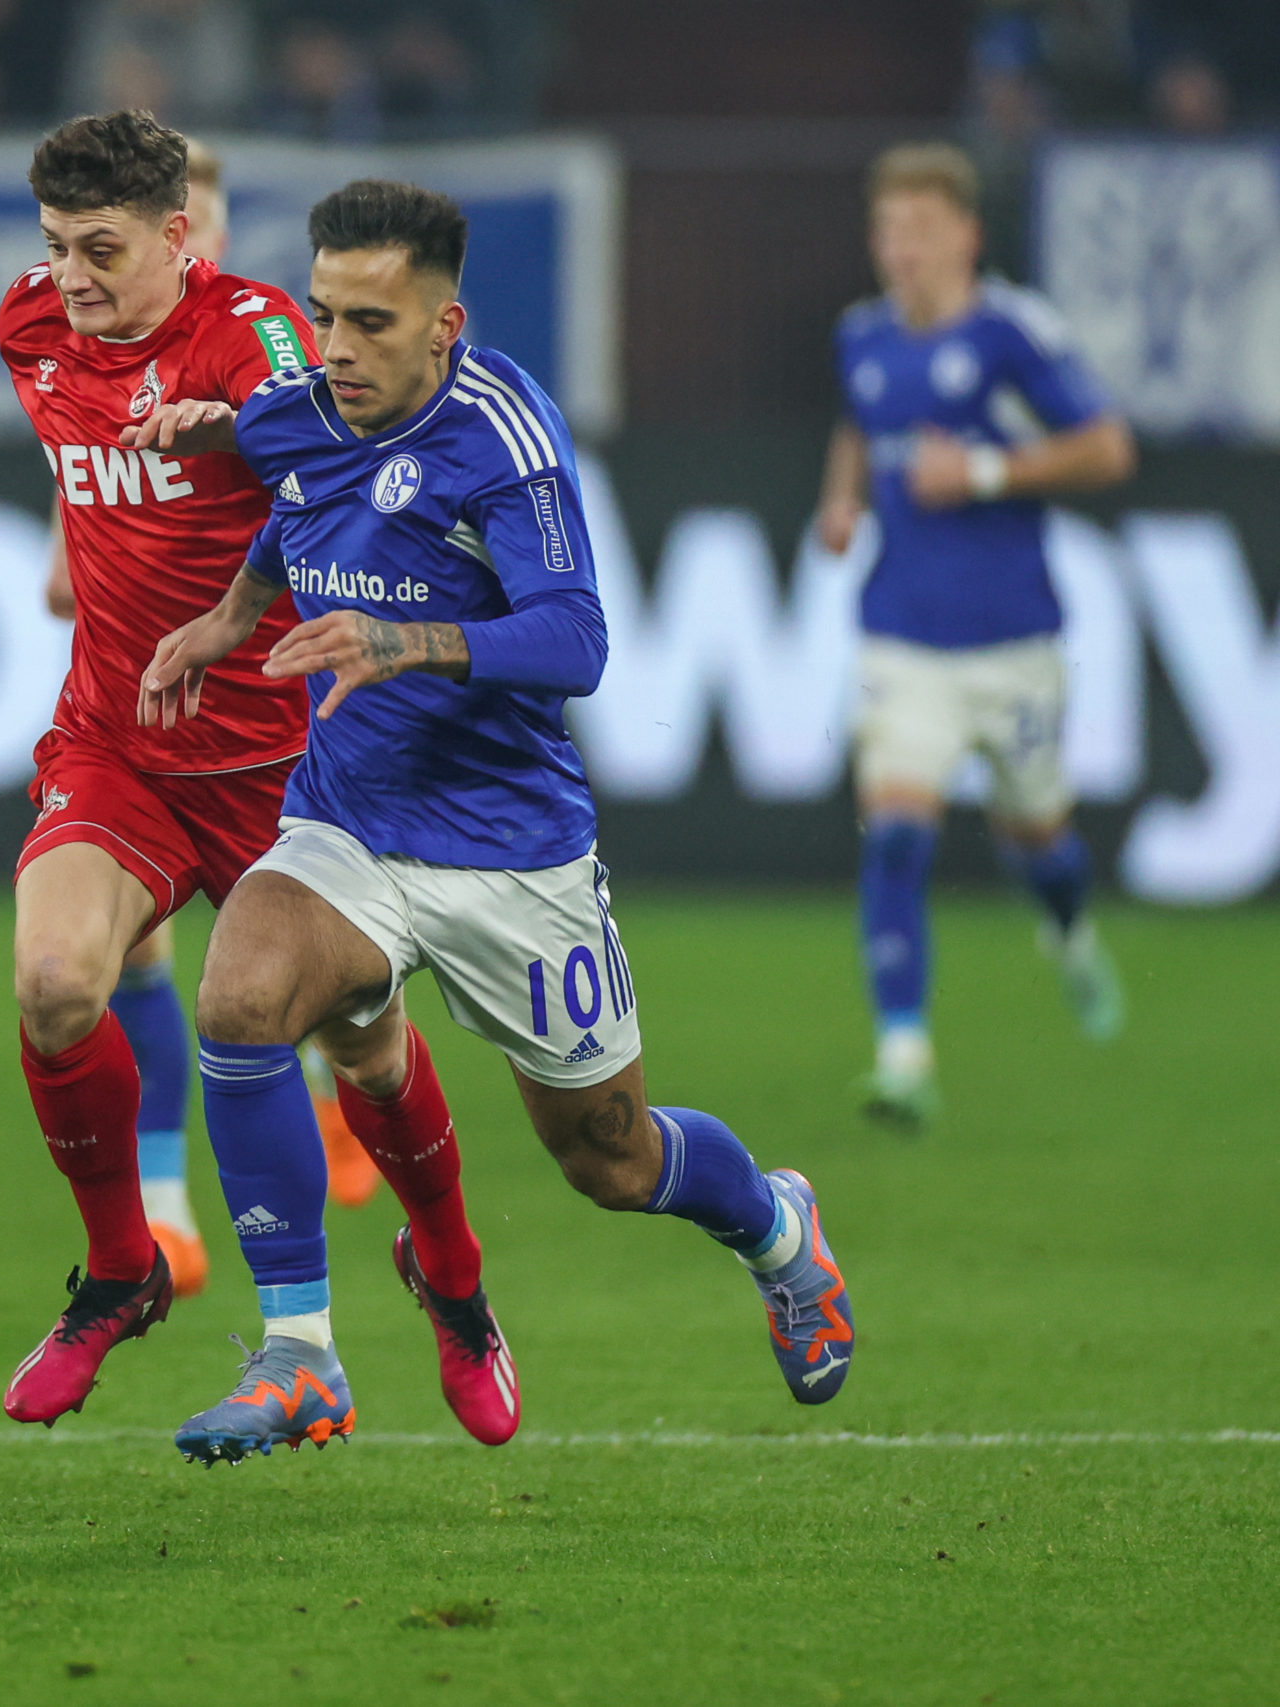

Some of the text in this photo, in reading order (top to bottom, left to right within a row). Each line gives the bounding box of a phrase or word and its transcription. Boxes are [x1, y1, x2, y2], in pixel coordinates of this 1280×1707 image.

[261, 319, 300, 367] DEVK
[41, 442, 195, 506] EWE
[279, 487, 305, 506] adidas
[534, 483, 565, 569] WHITEFIELD
[283, 555, 429, 603] einAuto.de
[528, 945, 602, 1036] 10
[564, 1044, 605, 1064] adidas
